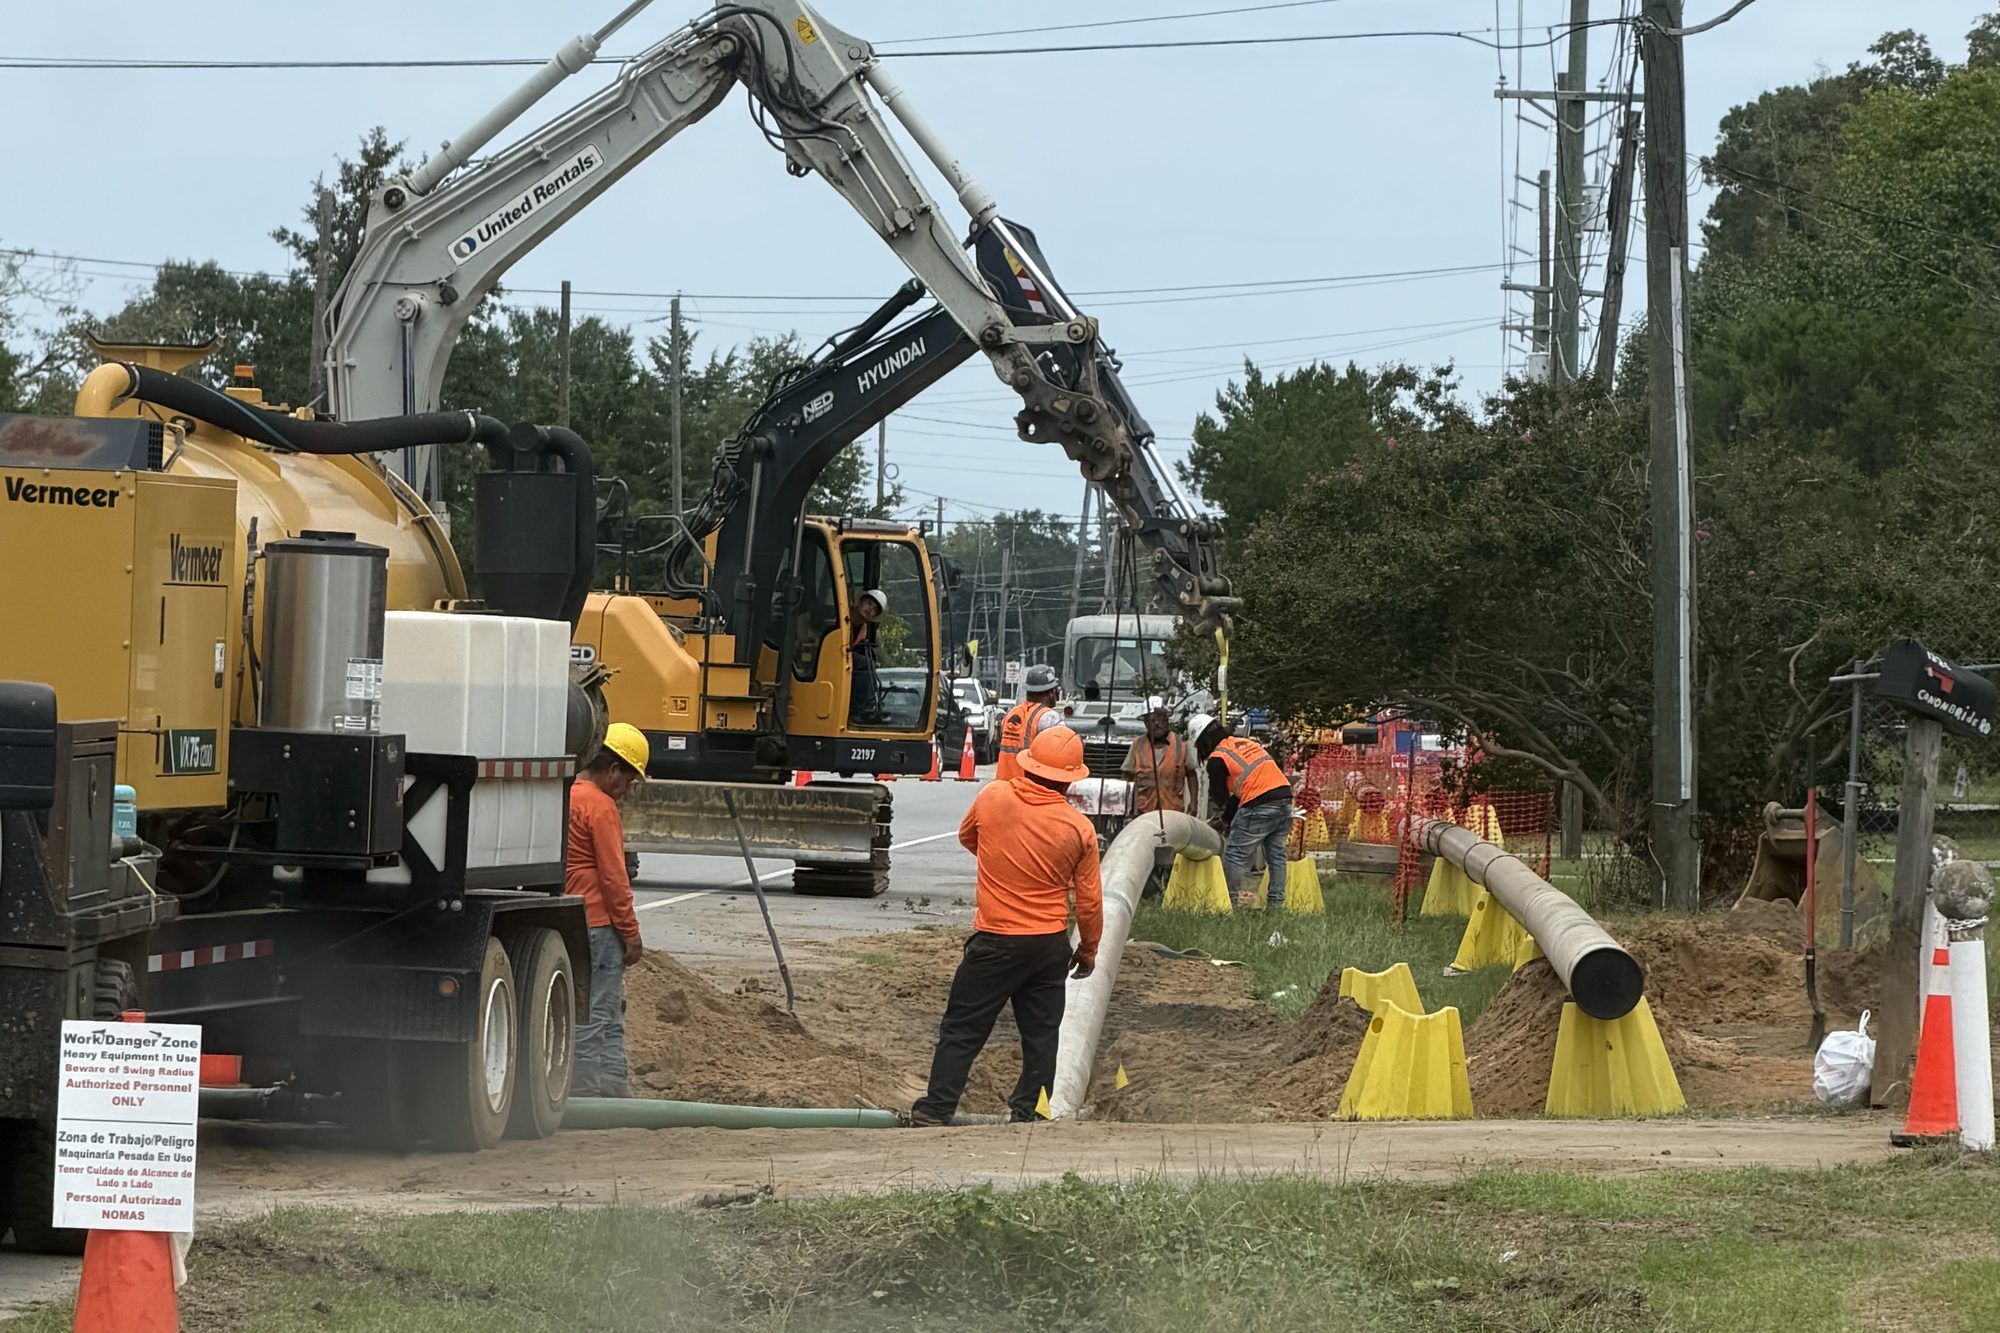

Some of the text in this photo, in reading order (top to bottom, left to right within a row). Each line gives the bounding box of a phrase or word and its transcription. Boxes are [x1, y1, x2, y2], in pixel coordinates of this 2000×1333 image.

[477, 156, 594, 242] United Rentals
[857, 336, 927, 394] HYUNDAI
[802, 390, 834, 419] NED
[5, 476, 119, 507] Vermeer
[170, 533, 223, 582] Vermeer
[569, 645, 596, 662] ED
[851, 748, 876, 760] 22197
[64, 1032, 199, 1049] Work/Danger Zone
[63, 1050, 198, 1063] Heavy Equipment In Use
[65, 1063, 194, 1077] Beware of Swing Radius
[66, 1078, 192, 1092] Authorized Personnel
[112, 1096, 145, 1106] ONLY
[58, 1131, 195, 1149] Zona de Trabajo/Peligro
[59, 1148, 193, 1163] Maquinaria Pesada En Uso
[58, 1164, 85, 1174] Tener
[86, 1165, 124, 1175] Cuidado
[141, 1168, 178, 1178] Alcance
[181, 1169, 193, 1178] de
[96, 1178, 119, 1188] Lado
[130, 1179, 153, 1189] Lado
[66, 1192, 182, 1206] Personal Autorizada
[101, 1210, 145, 1221] NOMAS
